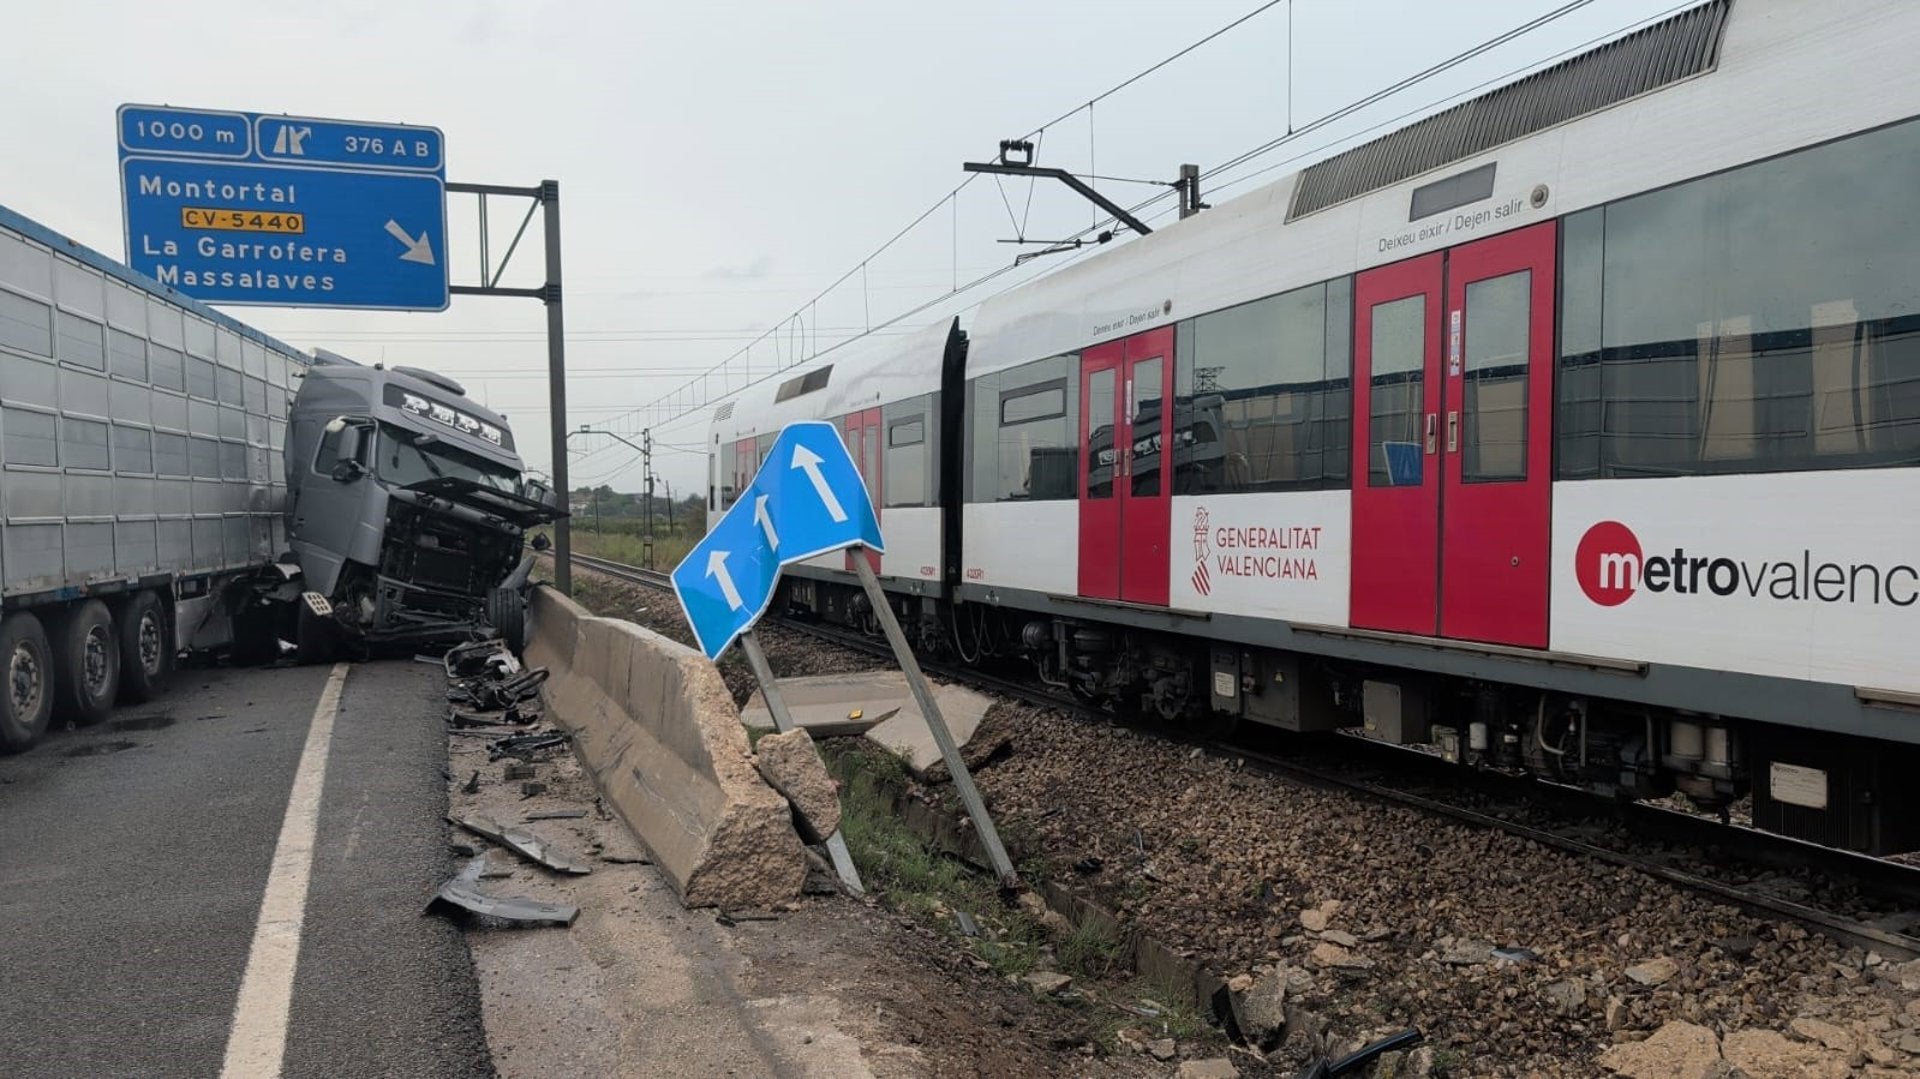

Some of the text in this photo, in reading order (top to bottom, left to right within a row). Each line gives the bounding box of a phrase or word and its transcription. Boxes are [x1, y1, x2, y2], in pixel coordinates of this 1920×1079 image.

[137, 119, 236, 143] 1000 m
[345, 136, 429, 157] 376 A B
[139, 174, 296, 204] Montortal
[185, 210, 300, 231] CV-5440
[1378, 231, 1415, 252] Deixeu
[1419, 223, 1444, 241] eixir
[1454, 210, 1491, 231] Dejen
[1494, 199, 1524, 220] salir
[143, 234, 347, 264] La Garrofera
[156, 264, 334, 291] Massalaves
[1216, 527, 1322, 550] GENERALITAT
[1216, 555, 1318, 580] VALENCIANA
